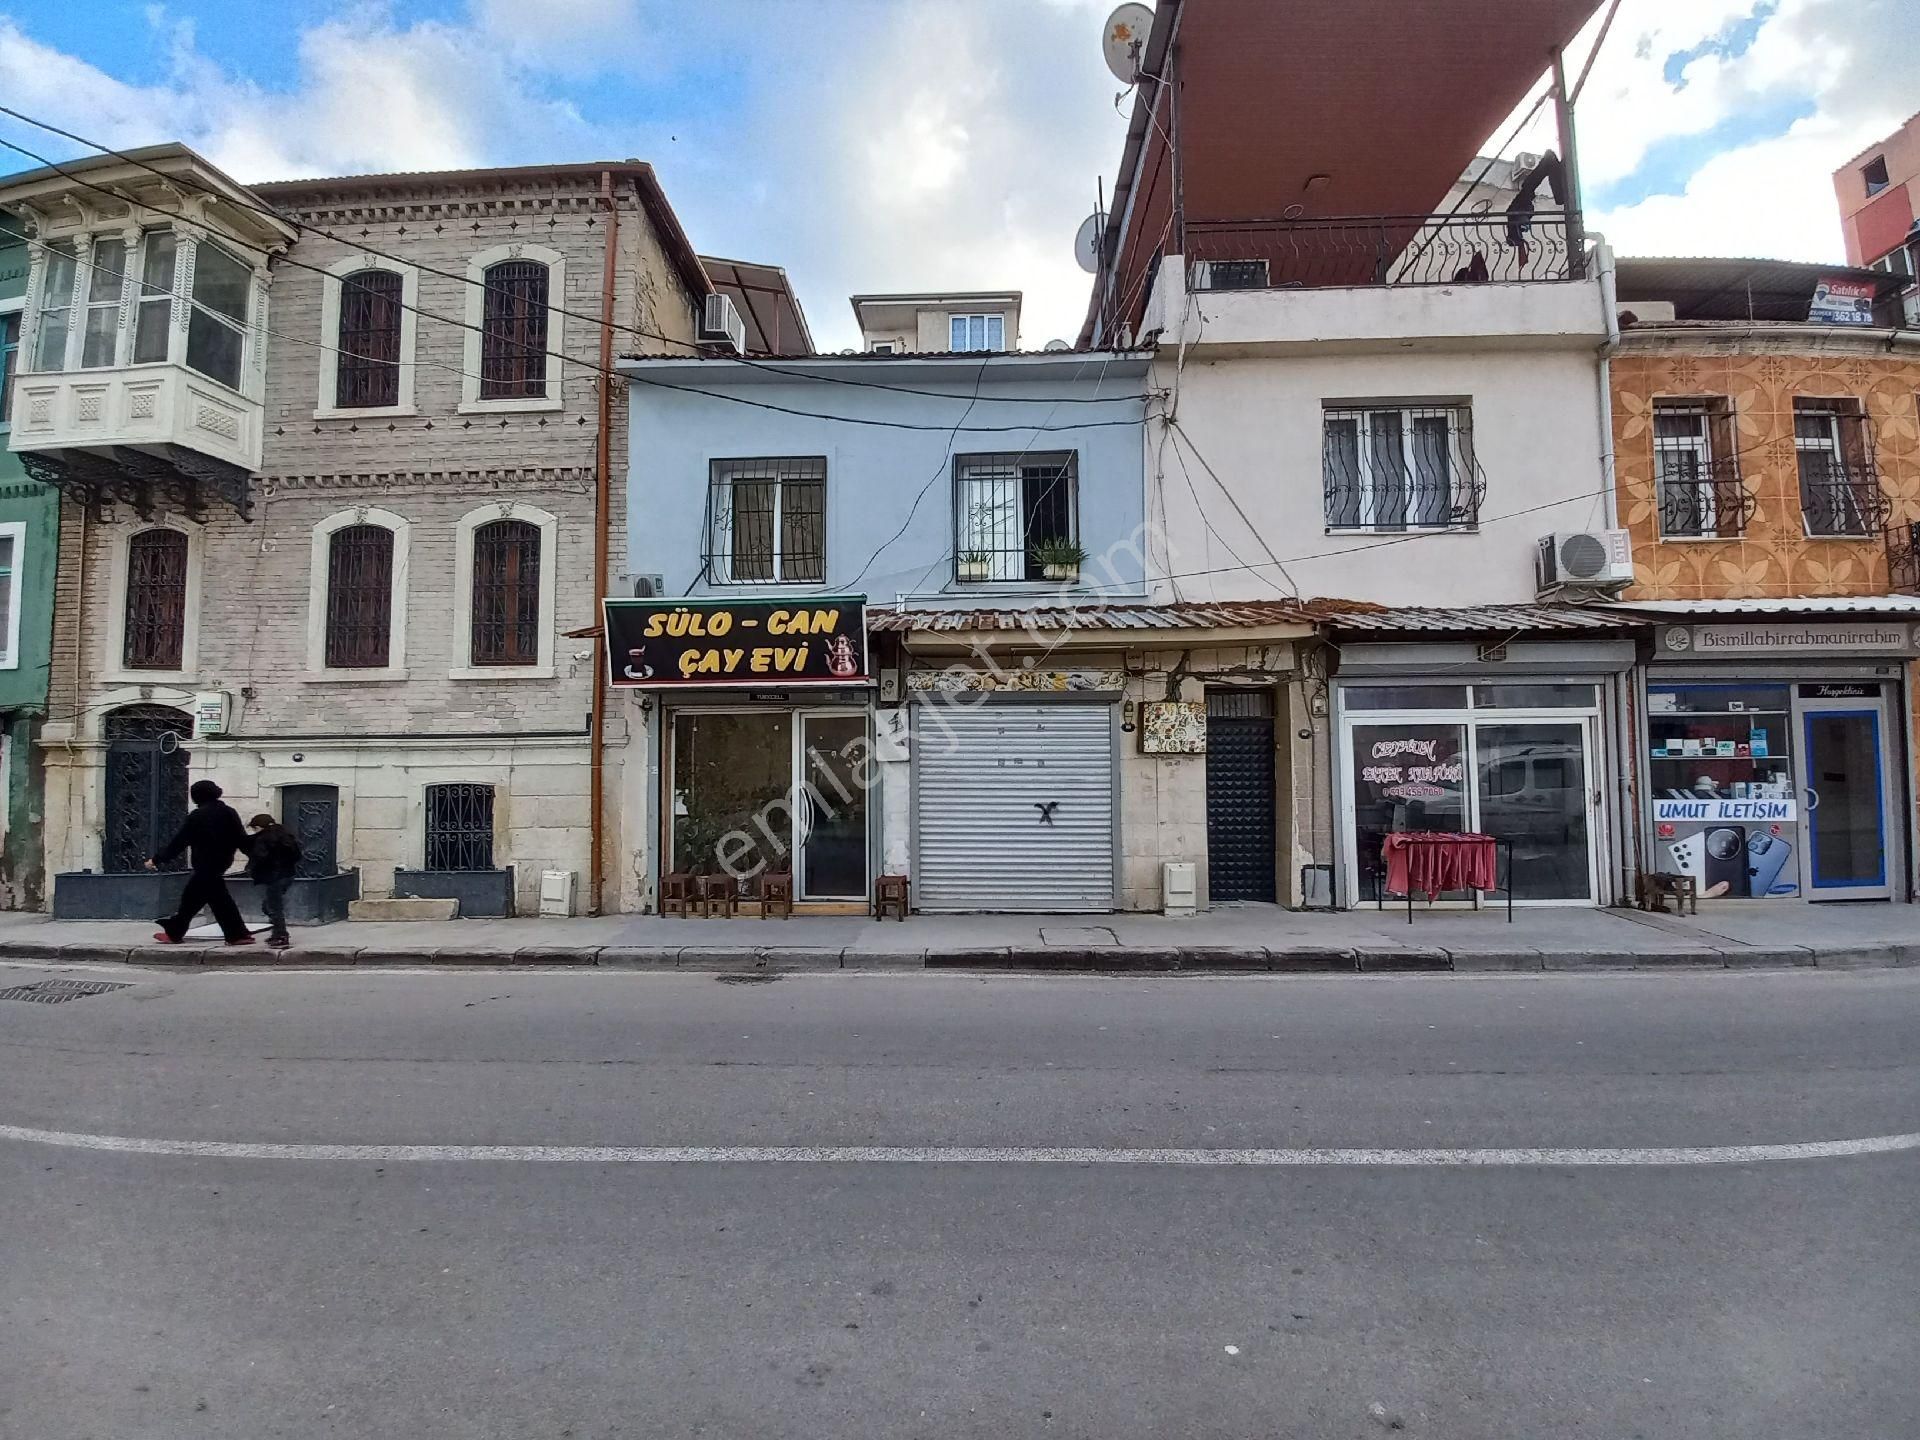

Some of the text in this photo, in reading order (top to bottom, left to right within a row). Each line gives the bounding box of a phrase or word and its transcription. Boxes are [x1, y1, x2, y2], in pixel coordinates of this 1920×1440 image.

[644, 607, 733, 637] SÜLO
[767, 609, 840, 636] CAN
[678, 641, 809, 679] ÇAY EVİ
[1659, 801, 1788, 819] UMUT İLETİŞİM
